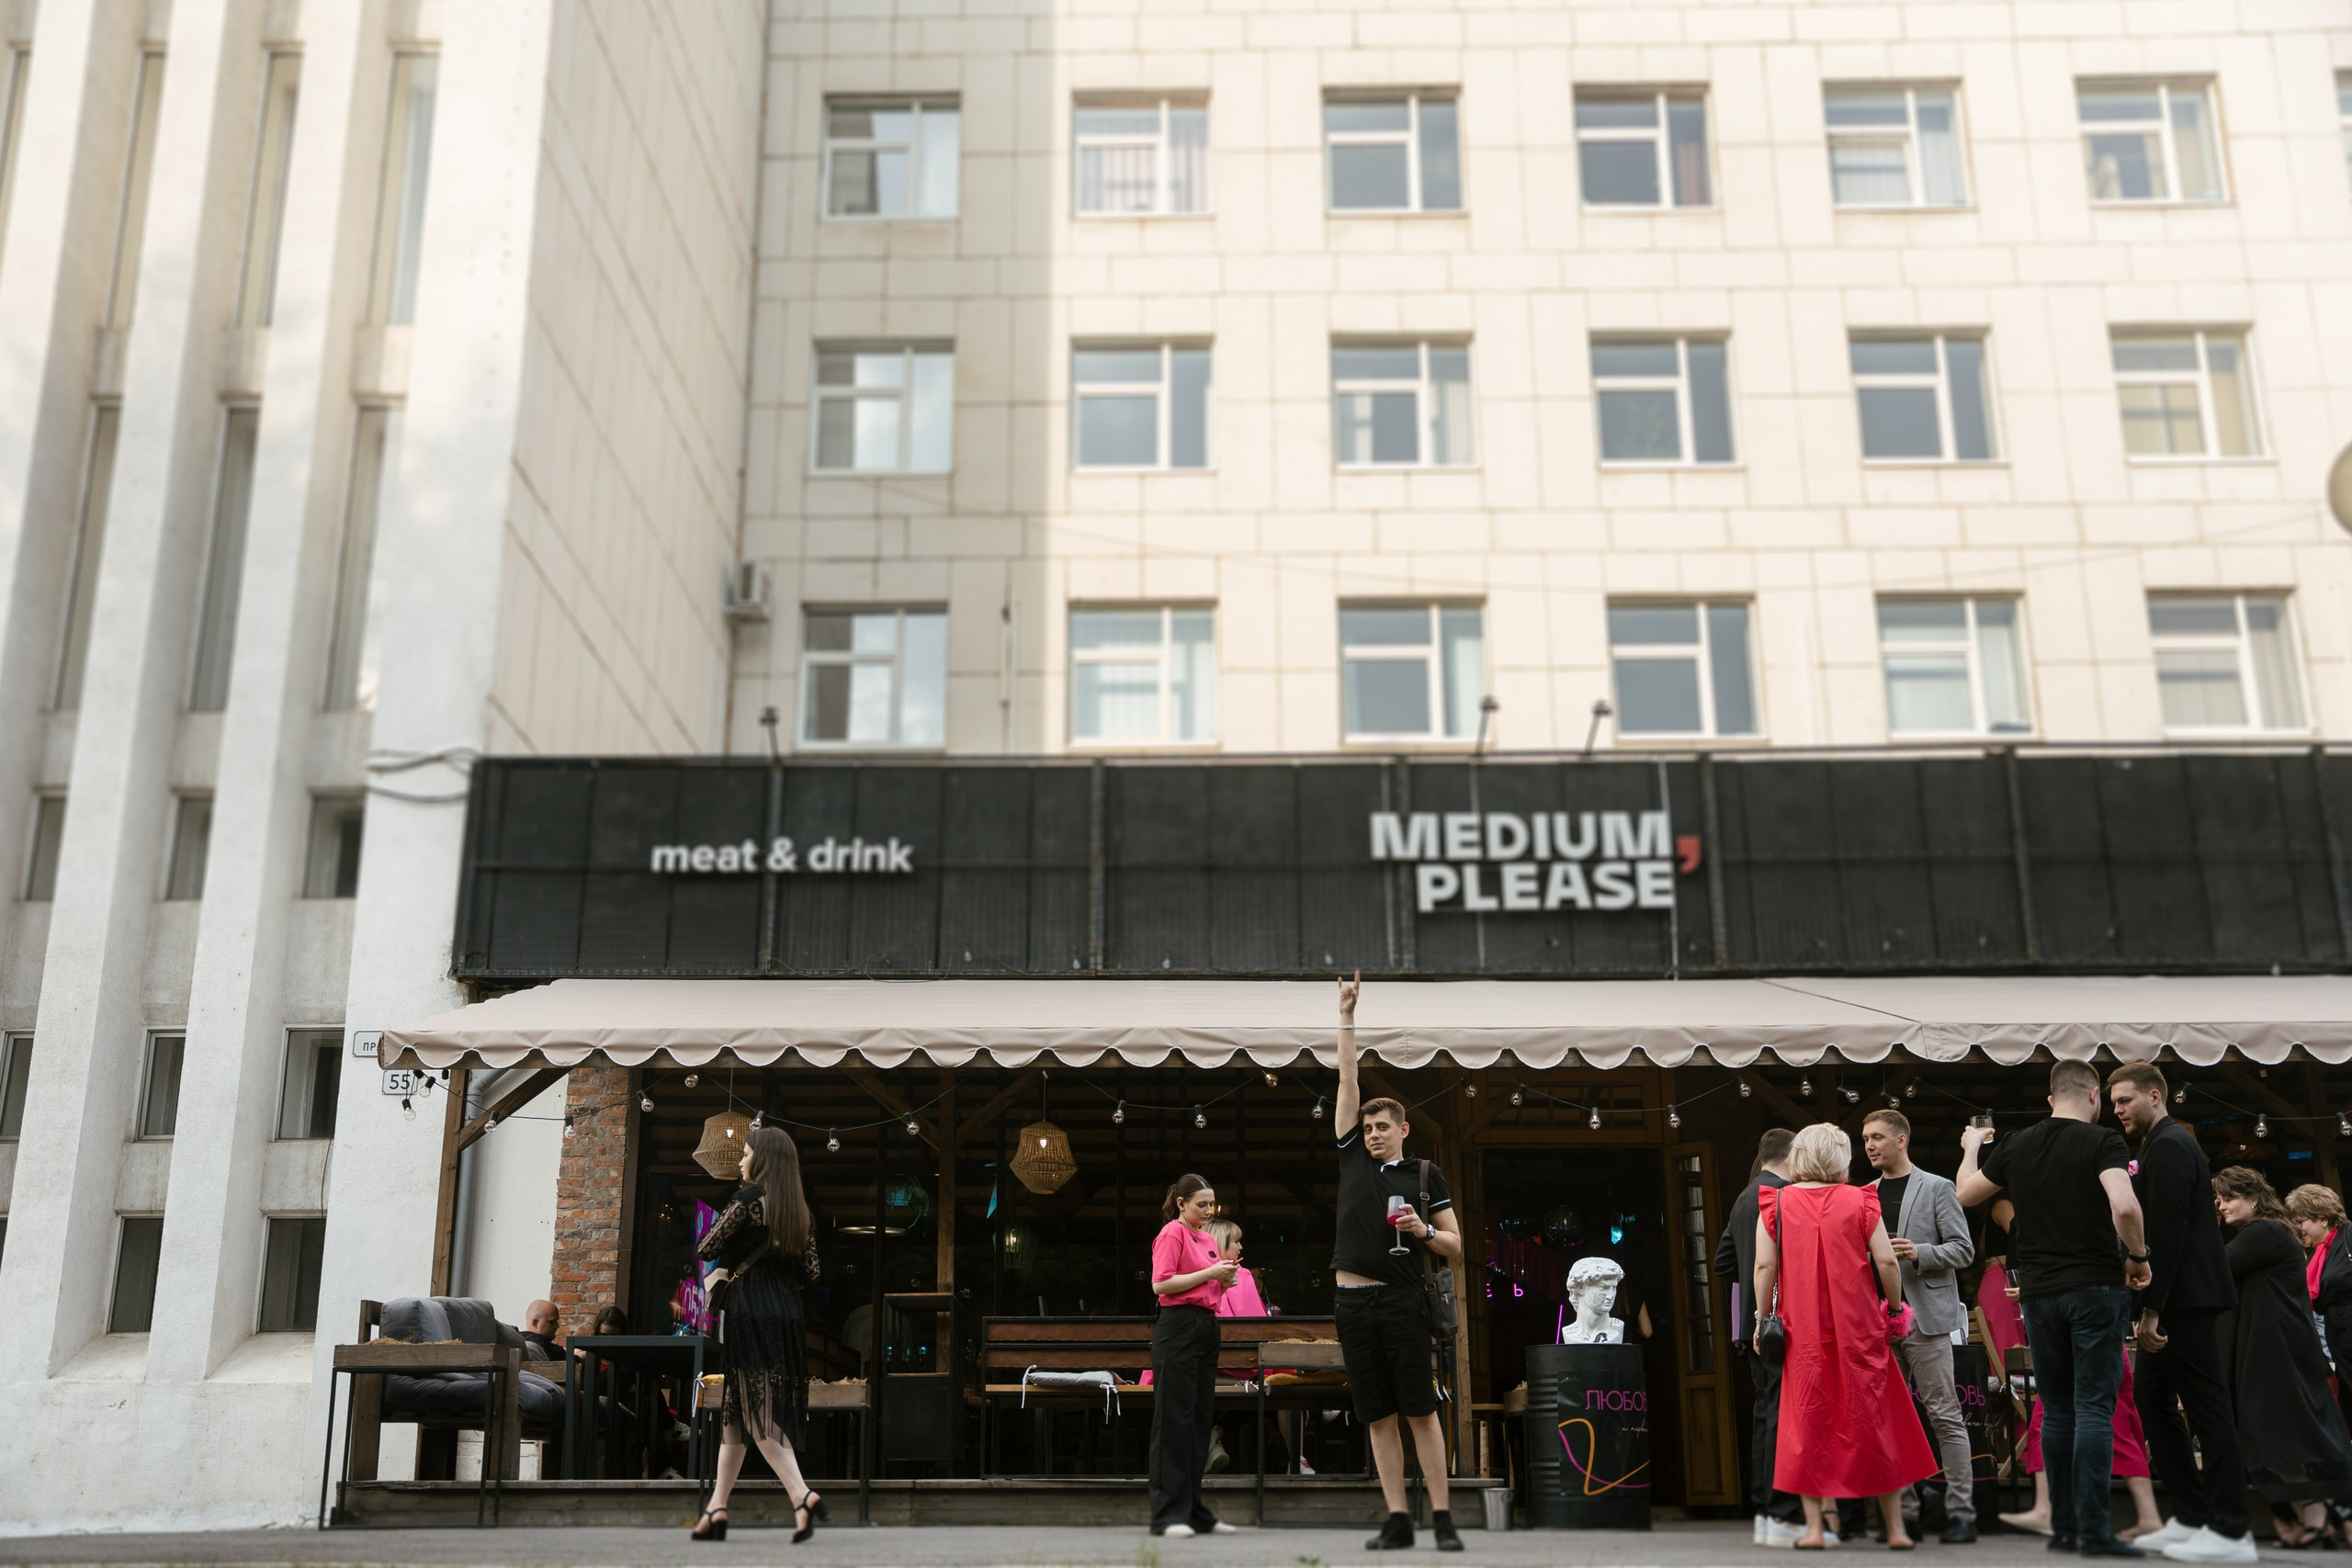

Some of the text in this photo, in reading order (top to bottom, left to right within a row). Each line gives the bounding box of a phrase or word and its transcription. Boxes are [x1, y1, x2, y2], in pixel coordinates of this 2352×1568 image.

[651, 837, 912, 872] meat & drink
[1370, 812, 1701, 874] MEDIUM,
[1416, 862, 1674, 911] PLEASE
[389, 1074, 411, 1090] 55
